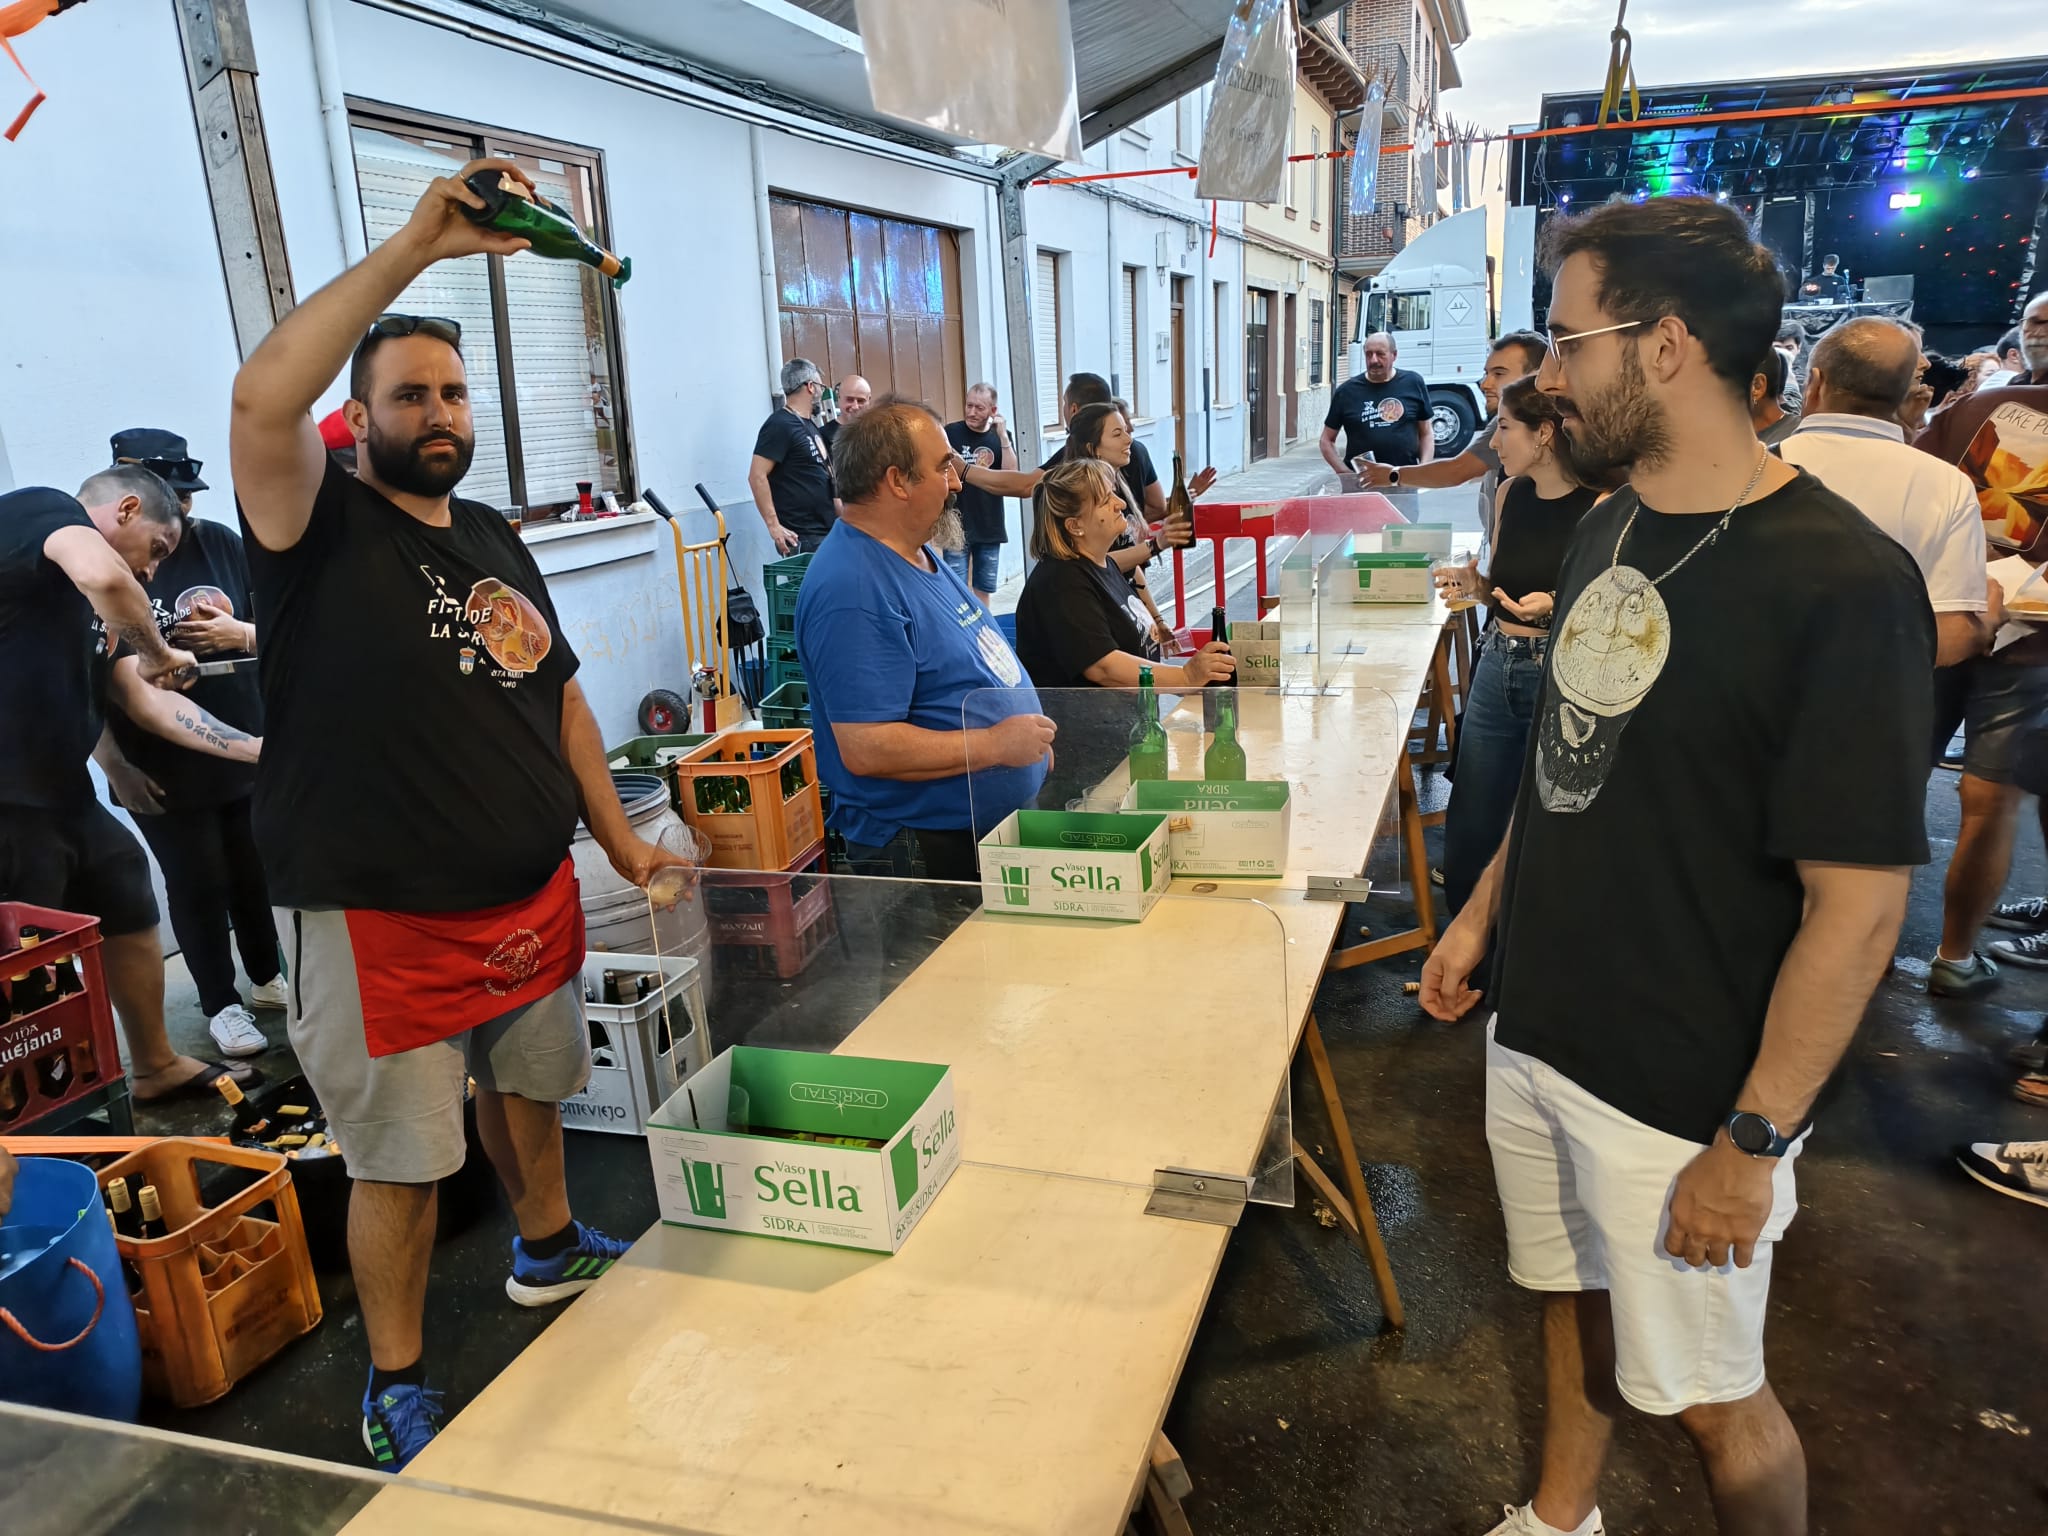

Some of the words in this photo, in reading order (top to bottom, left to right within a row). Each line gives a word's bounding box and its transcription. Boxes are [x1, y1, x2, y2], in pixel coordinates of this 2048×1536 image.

[1996, 405, 2036, 429] LAKE
[470, 606, 493, 625] DE
[430, 622, 451, 639] LA
[1245, 654, 1281, 669] Sella
[1197, 784, 1231, 795] SIDRA
[1065, 862, 1086, 873] Vaso
[1050, 865, 1121, 894] Sella
[1053, 901, 1086, 914] SIDRA
[0, 1026, 62, 1068] uejana
[798, 1085, 878, 1105] DKRISTAL
[560, 1100, 627, 1122] ONTEVIEJO
[921, 1108, 956, 1170] Sella
[774, 1160, 807, 1176] Vaso
[753, 1164, 864, 1214] Sella
[761, 1216, 809, 1234] SIDRA
